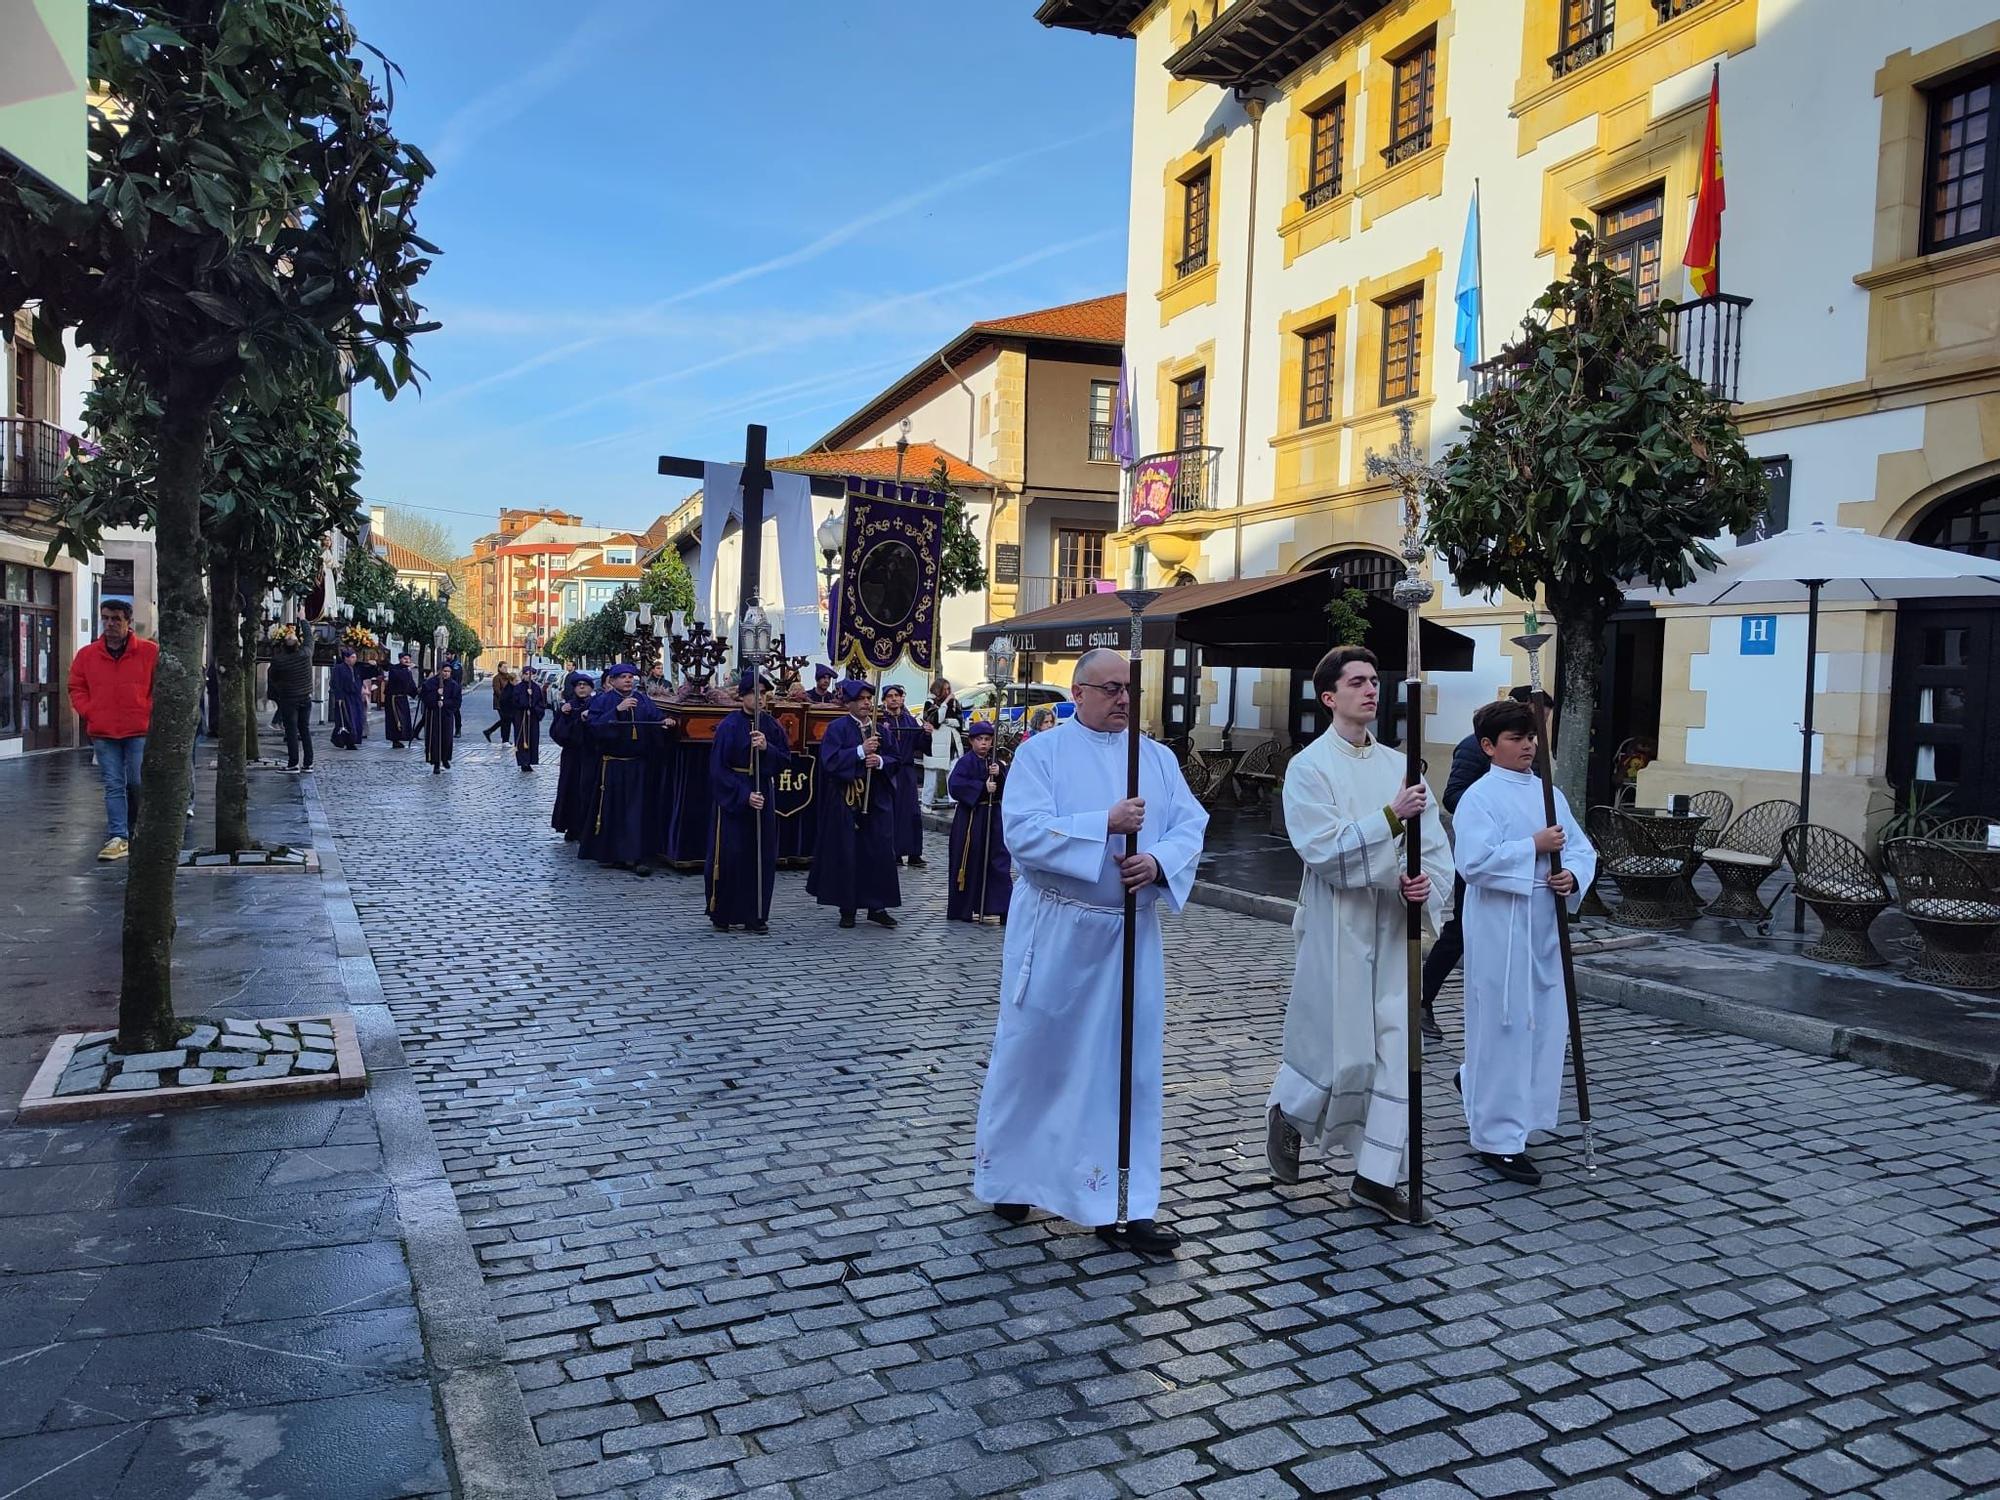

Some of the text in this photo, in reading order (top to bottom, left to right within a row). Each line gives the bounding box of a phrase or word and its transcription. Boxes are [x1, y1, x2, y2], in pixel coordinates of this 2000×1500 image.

[1765, 466, 1784, 479] SA
[1066, 627, 1119, 648] casa españa
[1747, 619, 1769, 641] H
[779, 769, 808, 791] HS
